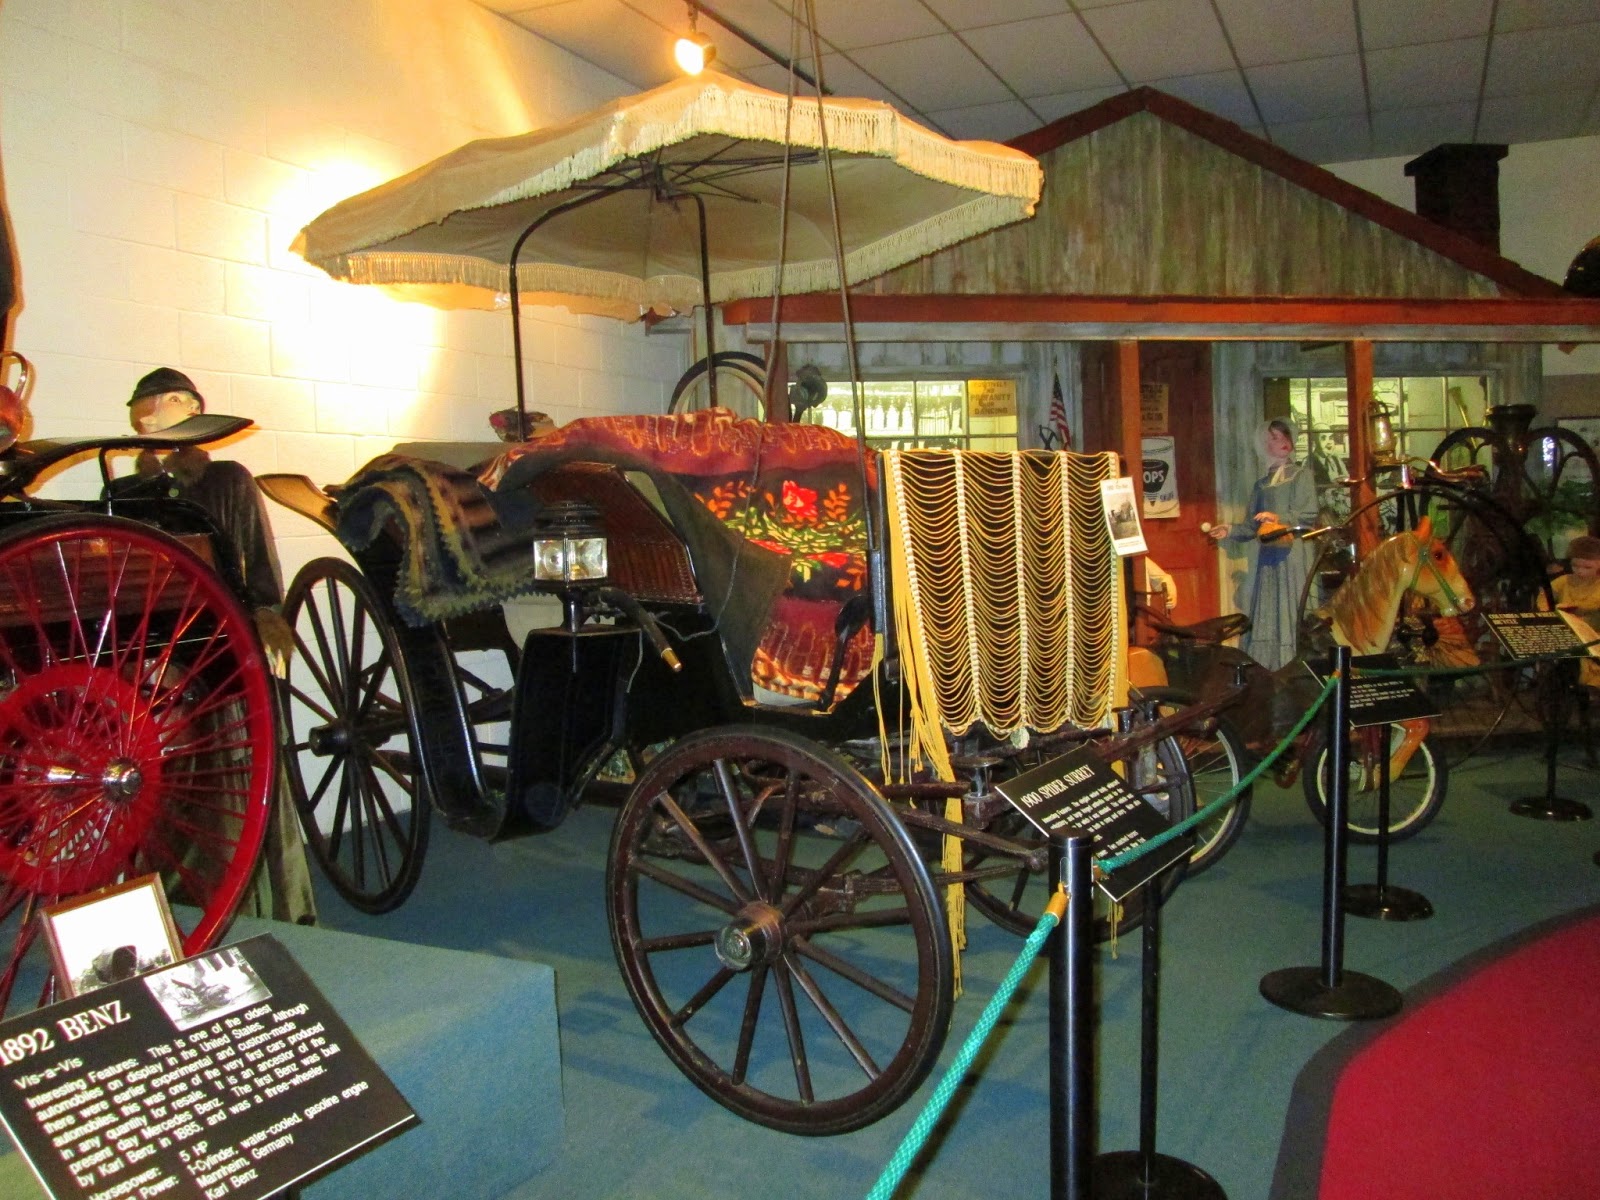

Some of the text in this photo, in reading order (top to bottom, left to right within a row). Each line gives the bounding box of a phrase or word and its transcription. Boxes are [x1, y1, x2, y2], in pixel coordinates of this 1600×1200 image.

[1142, 470, 1165, 484] OPS
[1020, 791, 1043, 808] 1900
[1037, 778, 1068, 799] SPIDER
[1062, 764, 1095, 786] SURREY
[0, 999, 132, 1067] 1892 BENZ
[25, 1078, 88, 1109] Interesting
[146, 1044, 173, 1059] This
[173, 1038, 187, 1049] is
[188, 1030, 209, 1043] one
[211, 1022, 225, 1035] of
[224, 1017, 242, 1032] the
[243, 1003, 273, 1021] oldest
[35, 1087, 104, 1122] automobiles
[106, 1079, 124, 1091] on
[125, 1061, 164, 1083] display
[165, 1056, 179, 1067] in
[179, 1048, 198, 1061] the
[198, 1033, 232, 1053] United
[272, 1002, 310, 1024] Although
[13, 1057, 83, 1090] Vis-a-Vis
[42, 1021, 303, 1135] there were earlier experimental and custom-made
[59, 1148, 75, 1161] in
[77, 1135, 101, 1153] any
[105, 1115, 148, 1140] quantity
[149, 1105, 168, 1119] for
[214, 1080, 225, 1091] It
[225, 1075, 239, 1086] is
[240, 1067, 255, 1080] an
[256, 1049, 295, 1073] ancestor
[297, 1041, 310, 1054] of
[309, 1036, 326, 1050] the
[120, 1102, 141, 1117] this
[142, 1091, 166, 1107] was
[168, 1081, 189, 1096] one
[190, 1073, 203, 1087] of
[203, 1067, 222, 1081] the
[222, 1057, 245, 1072] very
[244, 1048, 265, 1062] first
[265, 1039, 287, 1054] cars
[286, 1021, 326, 1046] produced
[303, 1094, 340, 1120] gasoline
[340, 1081, 369, 1099] engine
[68, 1145, 114, 1175] present
[114, 1135, 139, 1152] day
[140, 1110, 193, 1140] Mercedes
[230, 1083, 253, 1097] The
[253, 1073, 274, 1088] first
[273, 1062, 300, 1079] Benz
[300, 1052, 321, 1067] was
[319, 1043, 341, 1058] built
[73, 1172, 95, 1188] by
[97, 1156, 125, 1177] Karl
[125, 1144, 157, 1164] Benz
[157, 1137, 172, 1149] in
[206, 1108, 228, 1126] and
[228, 1099, 252, 1115] was
[253, 1094, 264, 1104] a
[178, 1149, 191, 1163] 5
[191, 1140, 208, 1157] HP
[250, 1133, 294, 1160] Germany
[204, 1168, 259, 1200] Karl Benz
